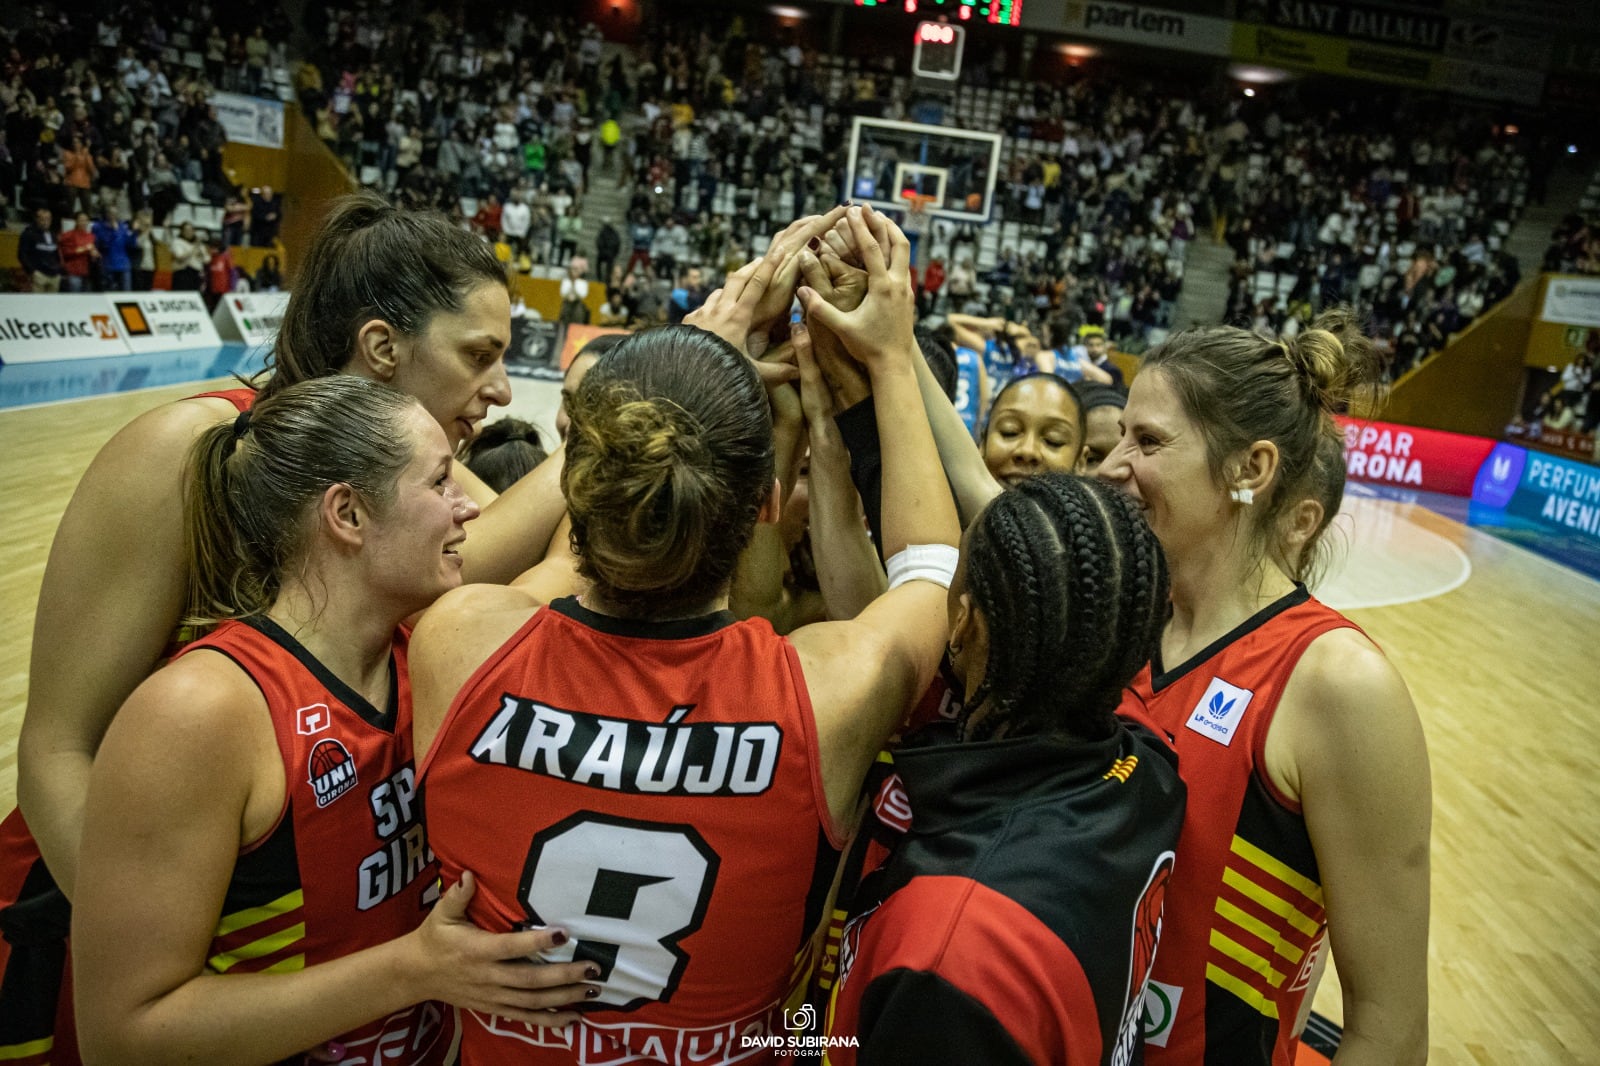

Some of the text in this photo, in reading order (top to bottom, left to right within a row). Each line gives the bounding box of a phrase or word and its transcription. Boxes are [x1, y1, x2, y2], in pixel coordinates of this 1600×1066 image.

[1085, 4, 1185, 36] parlem
[1343, 423, 1414, 457] SPAR
[470, 696, 781, 794] ARAÚJO
[314, 760, 355, 795] UNI
[319, 776, 356, 806] GIRONA
[524, 818, 712, 1008] 8
